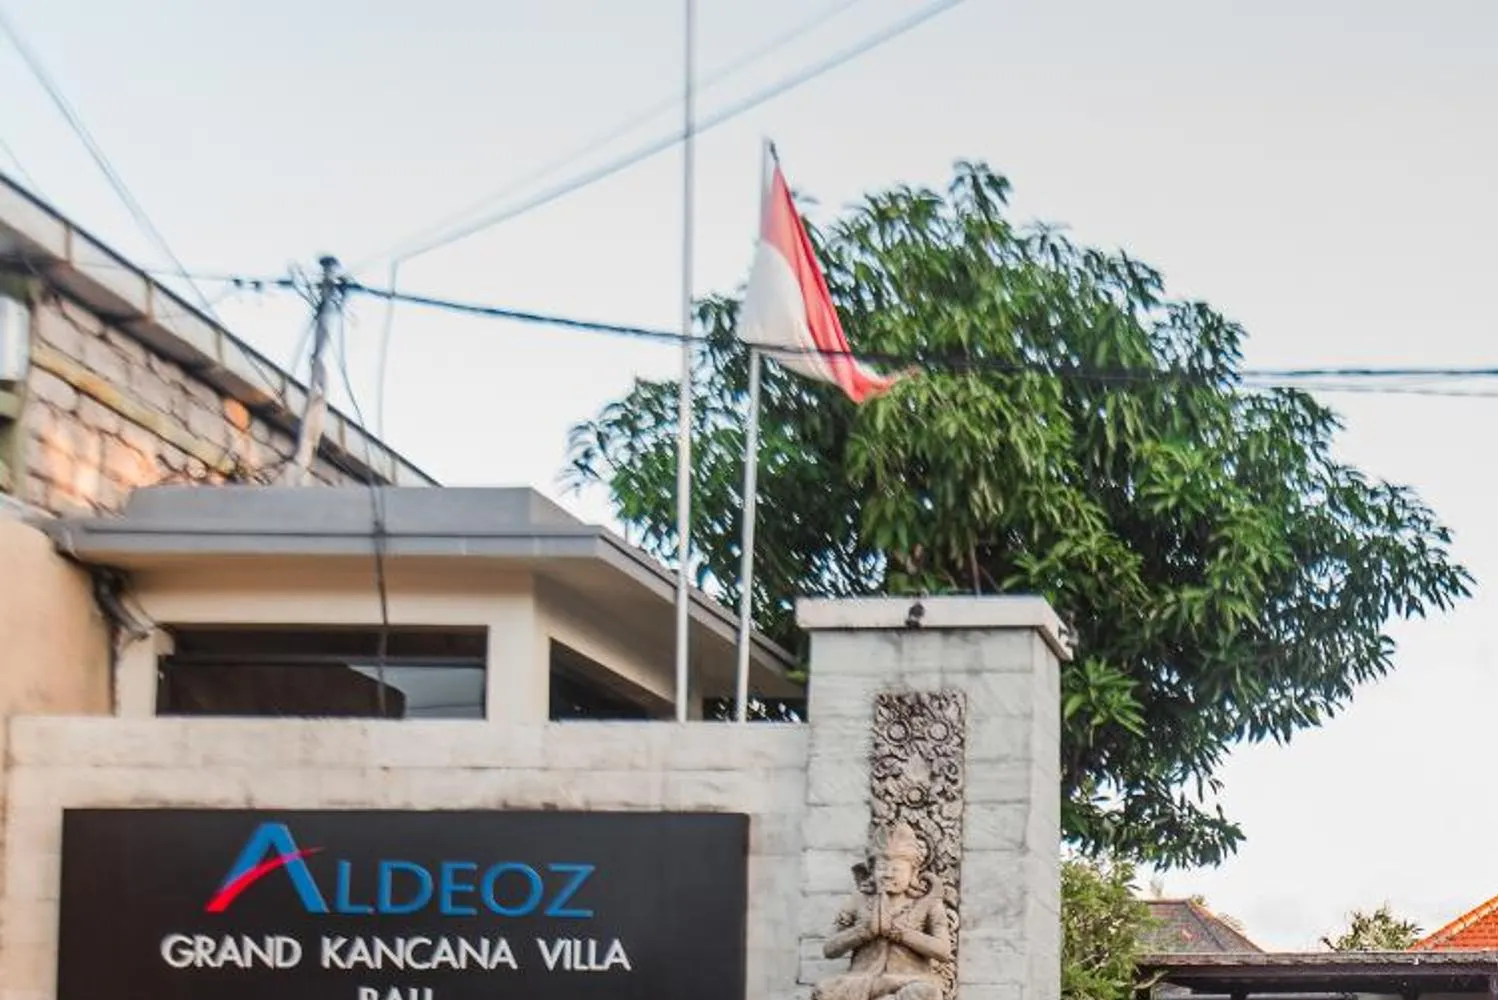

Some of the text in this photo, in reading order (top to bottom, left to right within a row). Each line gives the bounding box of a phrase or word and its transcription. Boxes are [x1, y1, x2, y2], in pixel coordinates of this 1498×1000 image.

[204, 820, 595, 919] ALDEOZ
[160, 933, 632, 972] GRAND KANCANA VILLA
